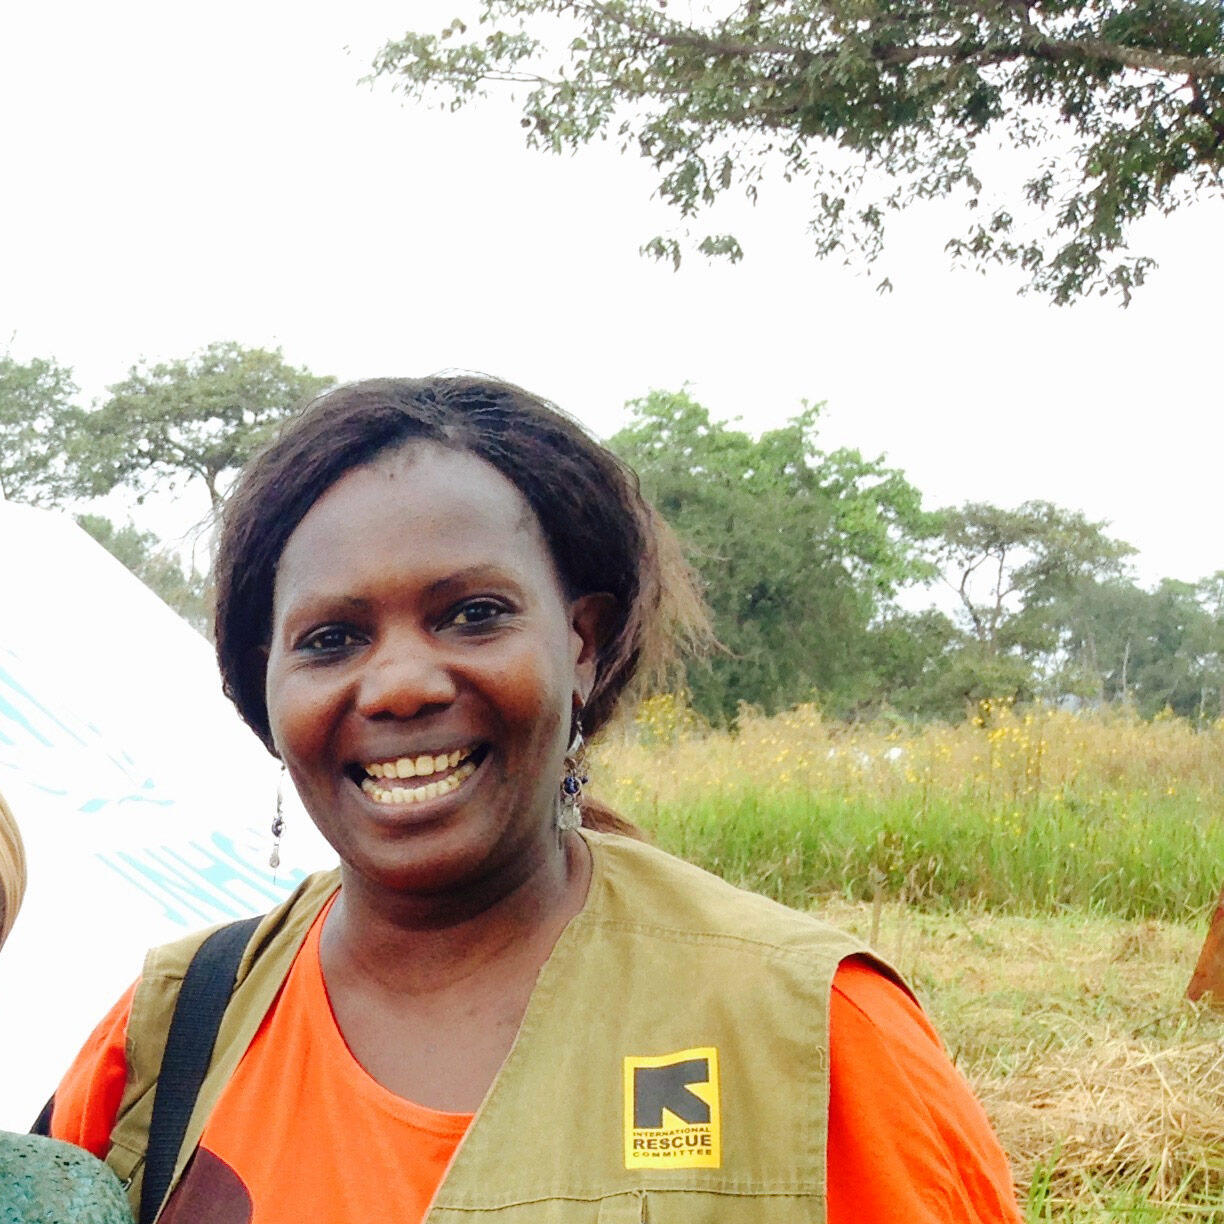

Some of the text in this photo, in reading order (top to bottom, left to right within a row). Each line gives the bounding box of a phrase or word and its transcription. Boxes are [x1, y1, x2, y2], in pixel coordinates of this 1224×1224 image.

[633, 1127, 712, 1137] INTERNATIONAL
[633, 1135, 711, 1150] RESCUE
[633, 1149, 712, 1158] COMMITTEE
